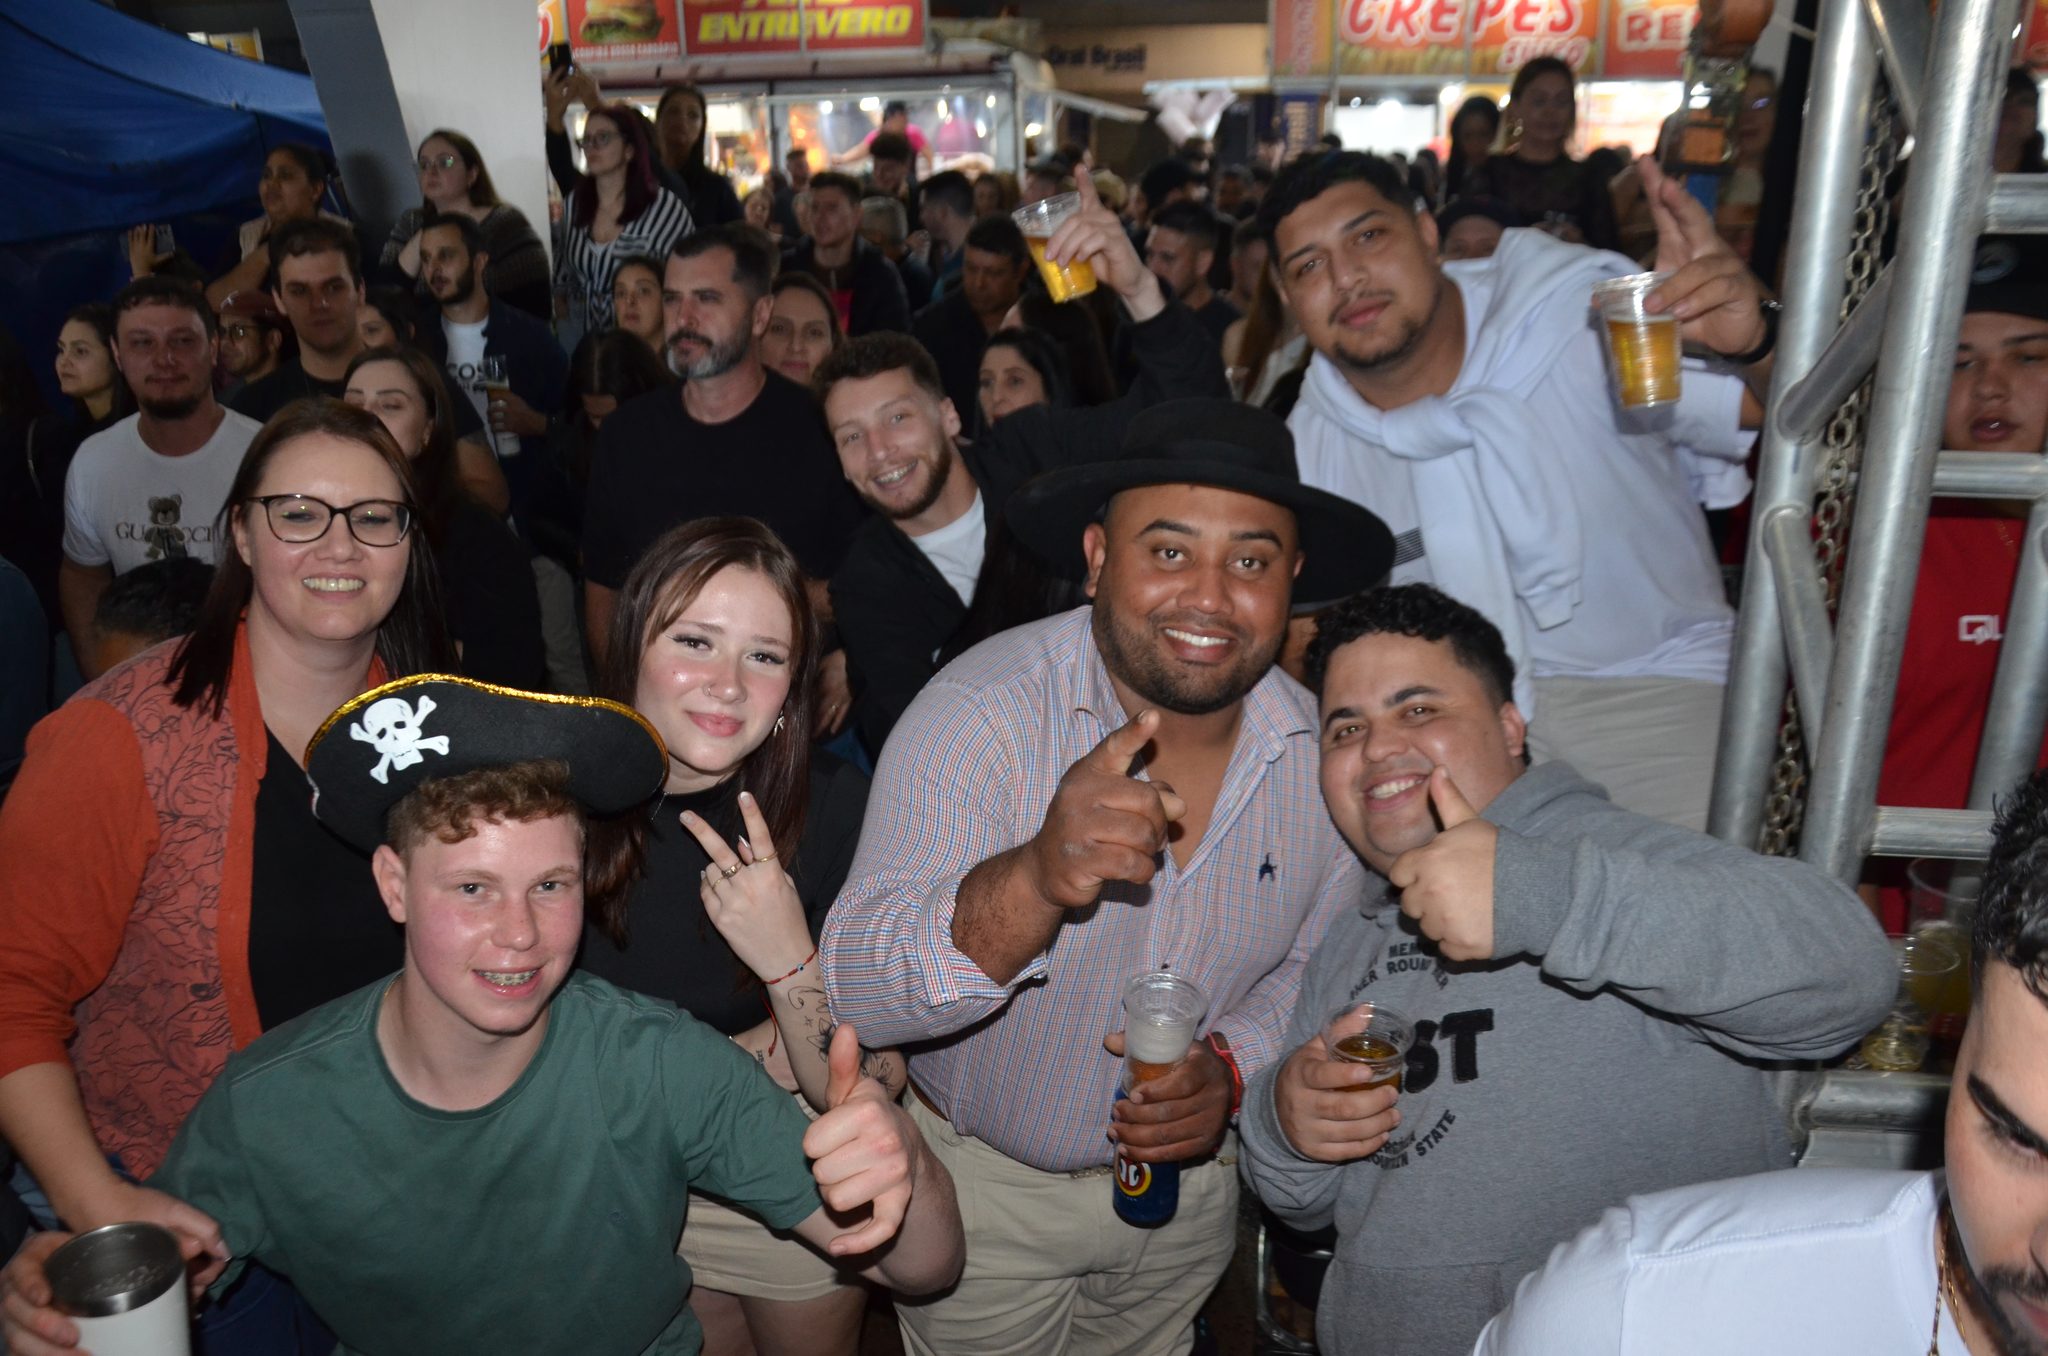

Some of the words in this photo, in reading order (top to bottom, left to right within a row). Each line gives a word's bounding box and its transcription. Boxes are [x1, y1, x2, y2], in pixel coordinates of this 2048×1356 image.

[700, 8, 911, 41] ENTREVERO
[1345, 0, 1577, 39] CREPES
[1415, 1109, 1456, 1156] STATE
